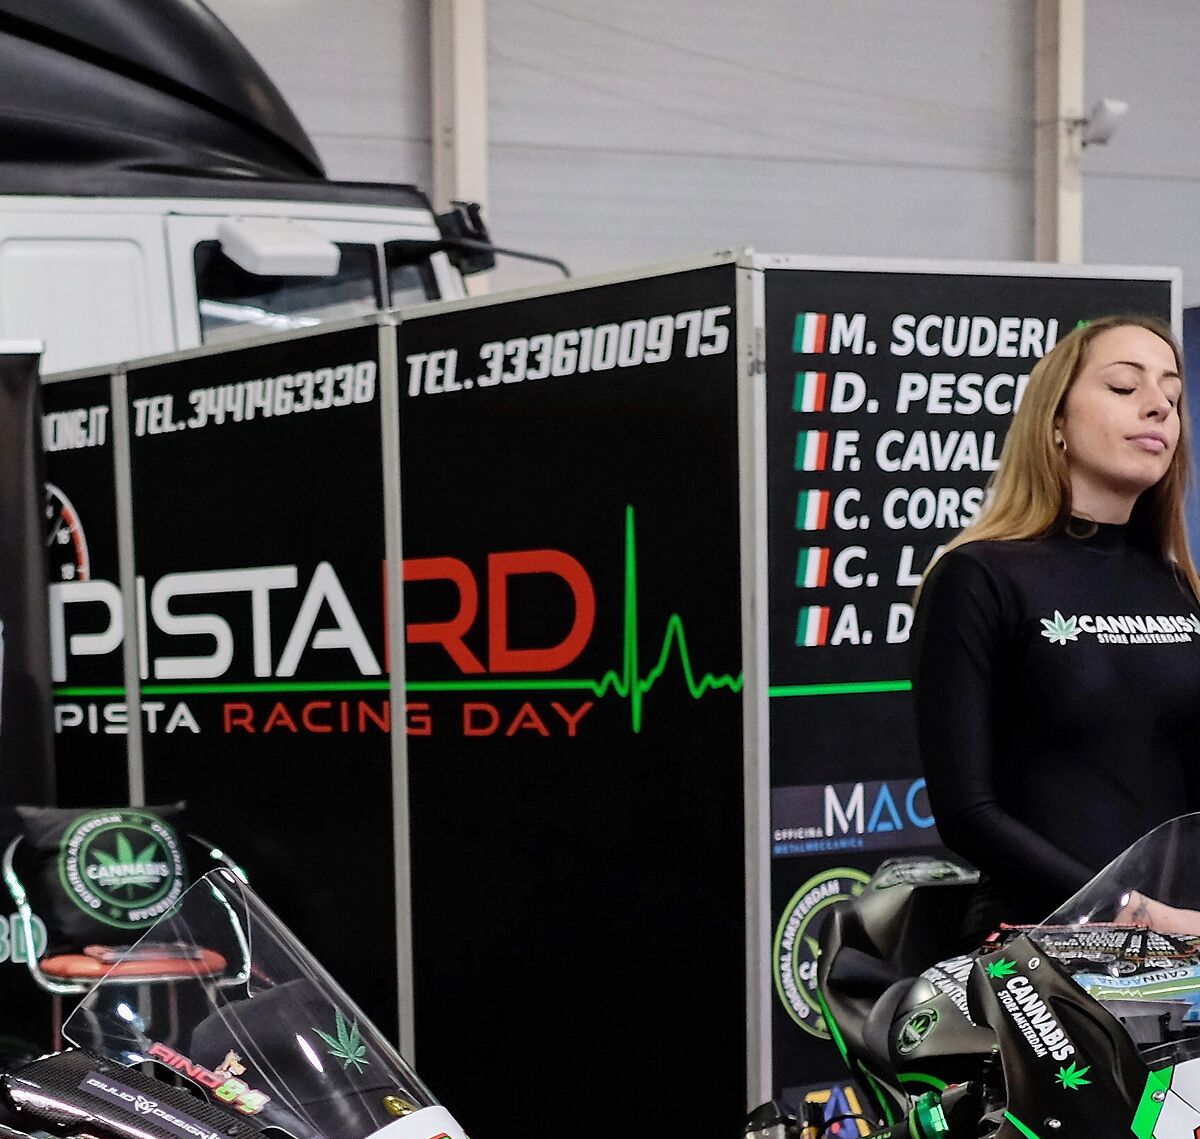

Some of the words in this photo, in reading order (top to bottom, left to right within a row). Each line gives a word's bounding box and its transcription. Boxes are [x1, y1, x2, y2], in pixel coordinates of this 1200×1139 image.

[829, 313, 878, 355] M.
[830, 372, 879, 413] D.
[831, 430, 861, 471] F.
[875, 430, 1001, 472] CAVAL
[833, 488, 870, 530] C.
[882, 487, 996, 529] CORS
[832, 547, 879, 588] C.
[50, 548, 597, 682] PISTARD
[830, 605, 873, 645] A.
[1078, 615, 1194, 634] CANNABIS
[1129, 632, 1193, 645] AMSTERDAM
[54, 702, 201, 734] PISTA
[223, 700, 433, 735] RACING
[462, 702, 594, 737] DAY
[824, 777, 935, 838] MAC
[86, 863, 170, 880] CANNABIS
[997, 990, 1017, 1017] STORE
[1013, 1013, 1049, 1058] AMSTERDAM
[1006, 976, 1075, 1061] CANNABIS
